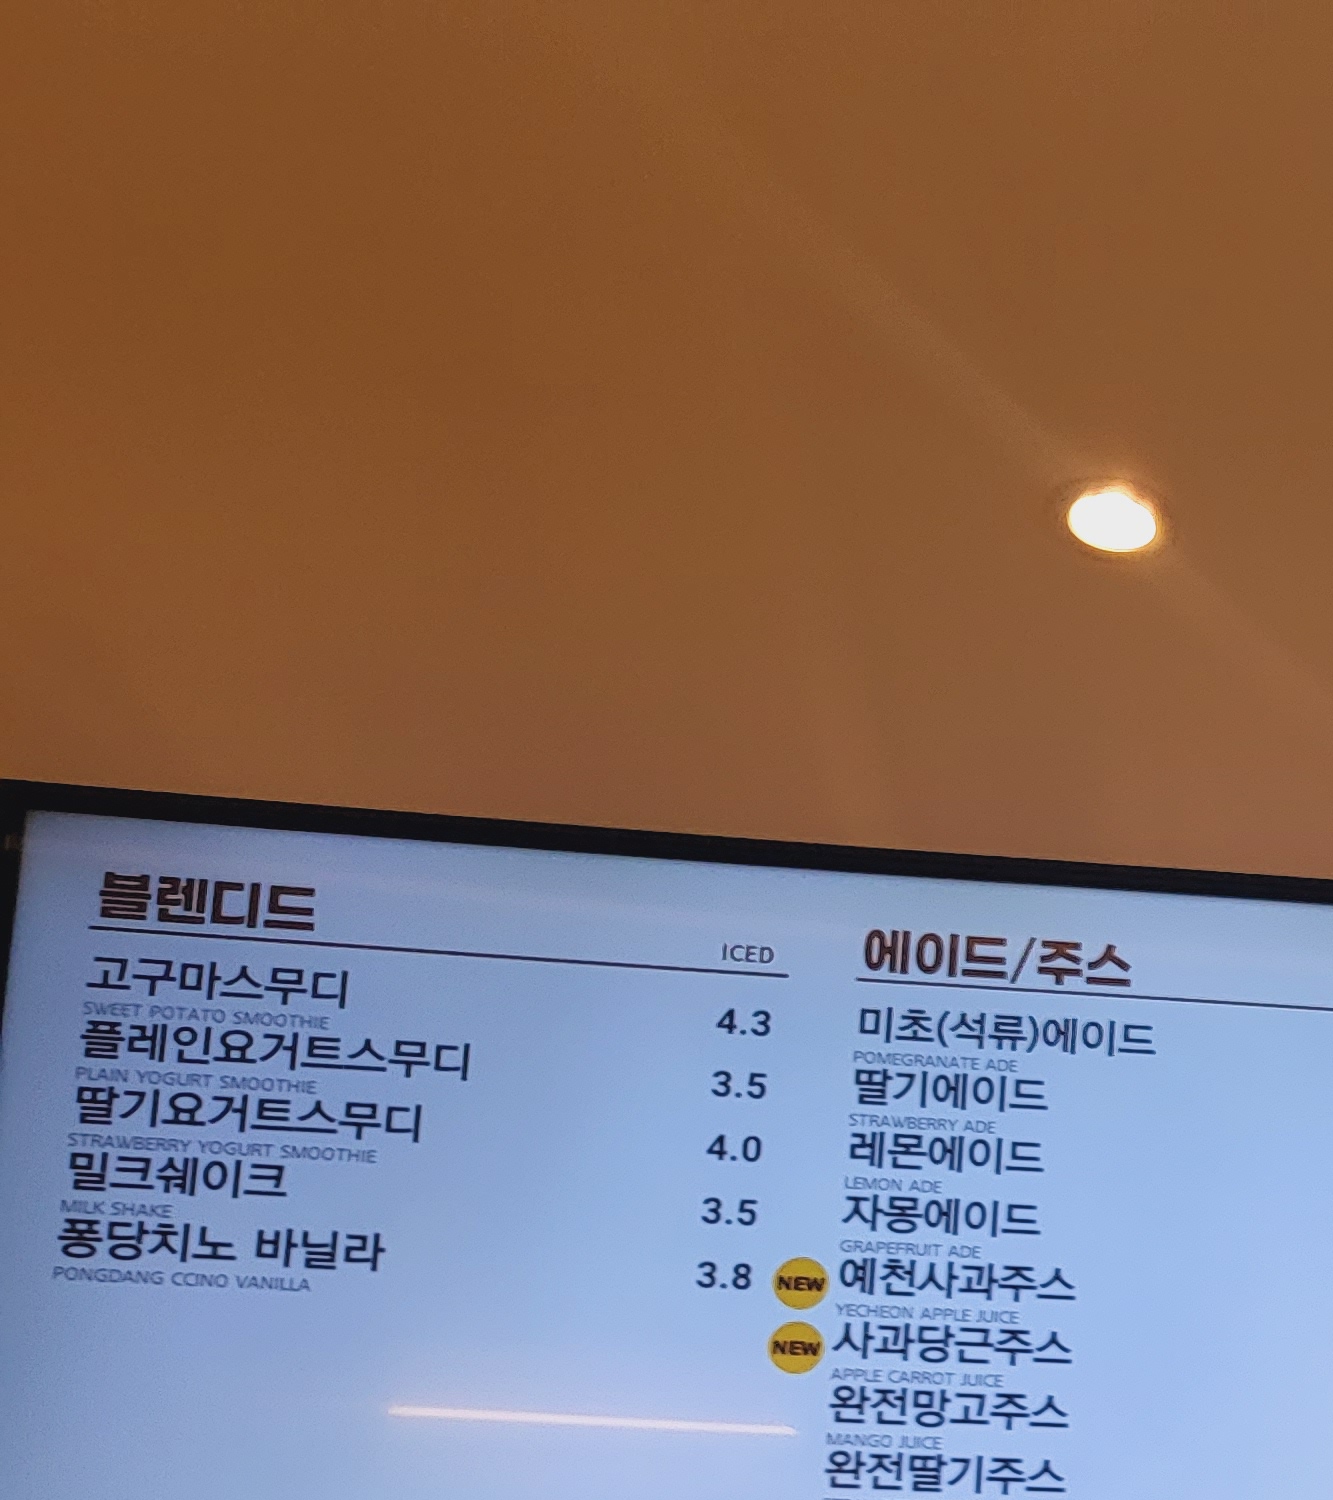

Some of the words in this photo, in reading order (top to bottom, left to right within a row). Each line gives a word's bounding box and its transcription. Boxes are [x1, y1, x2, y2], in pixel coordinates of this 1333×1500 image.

[98, 871, 315, 931] 블렌디드
[721, 943, 774, 964] ICED
[864, 929, 1131, 988] 에이드/주스
[86, 956, 350, 1008] 고구마스무디
[83, 1002, 142, 1019] SWEET
[149, 1006, 225, 1026] POTATO
[233, 1011, 329, 1030] SMOOTHIE
[716, 1009, 771, 1037] 4.3
[858, 1008, 1156, 1058] 미초(석류)에이드
[79, 1020, 471, 1080] 플레인요거트스무디
[711, 1072, 767, 1099] 3.5
[854, 1069, 1048, 1112] 딸기에이드
[75, 1086, 423, 1143] 딸기요거트스무디
[848, 1114, 956, 1132] STRAWBERRY
[961, 1119, 996, 1134] ADE
[706, 1135, 762, 1162] 4.0
[848, 1132, 1044, 1174] 레몬에이드
[68, 1152, 286, 1197] 밀크쉐이크
[60, 1200, 106, 1215] MILK
[114, 1202, 173, 1218] SHAKE
[842, 1195, 1041, 1236] 자몽에이드
[58, 1217, 237, 1263] 퐁당치노
[254, 1229, 385, 1271] 바닐라
[696, 1262, 751, 1290] 3.8
[776, 1274, 825, 1292] NEW
[839, 1259, 1076, 1301] 예천사과주스
[771, 1339, 821, 1358] NEW
[832, 1322, 1072, 1365] 사과당근주스
[829, 1386, 1069, 1430] 완전망고주스
[824, 1450, 1067, 1495] 완전딸기주스
